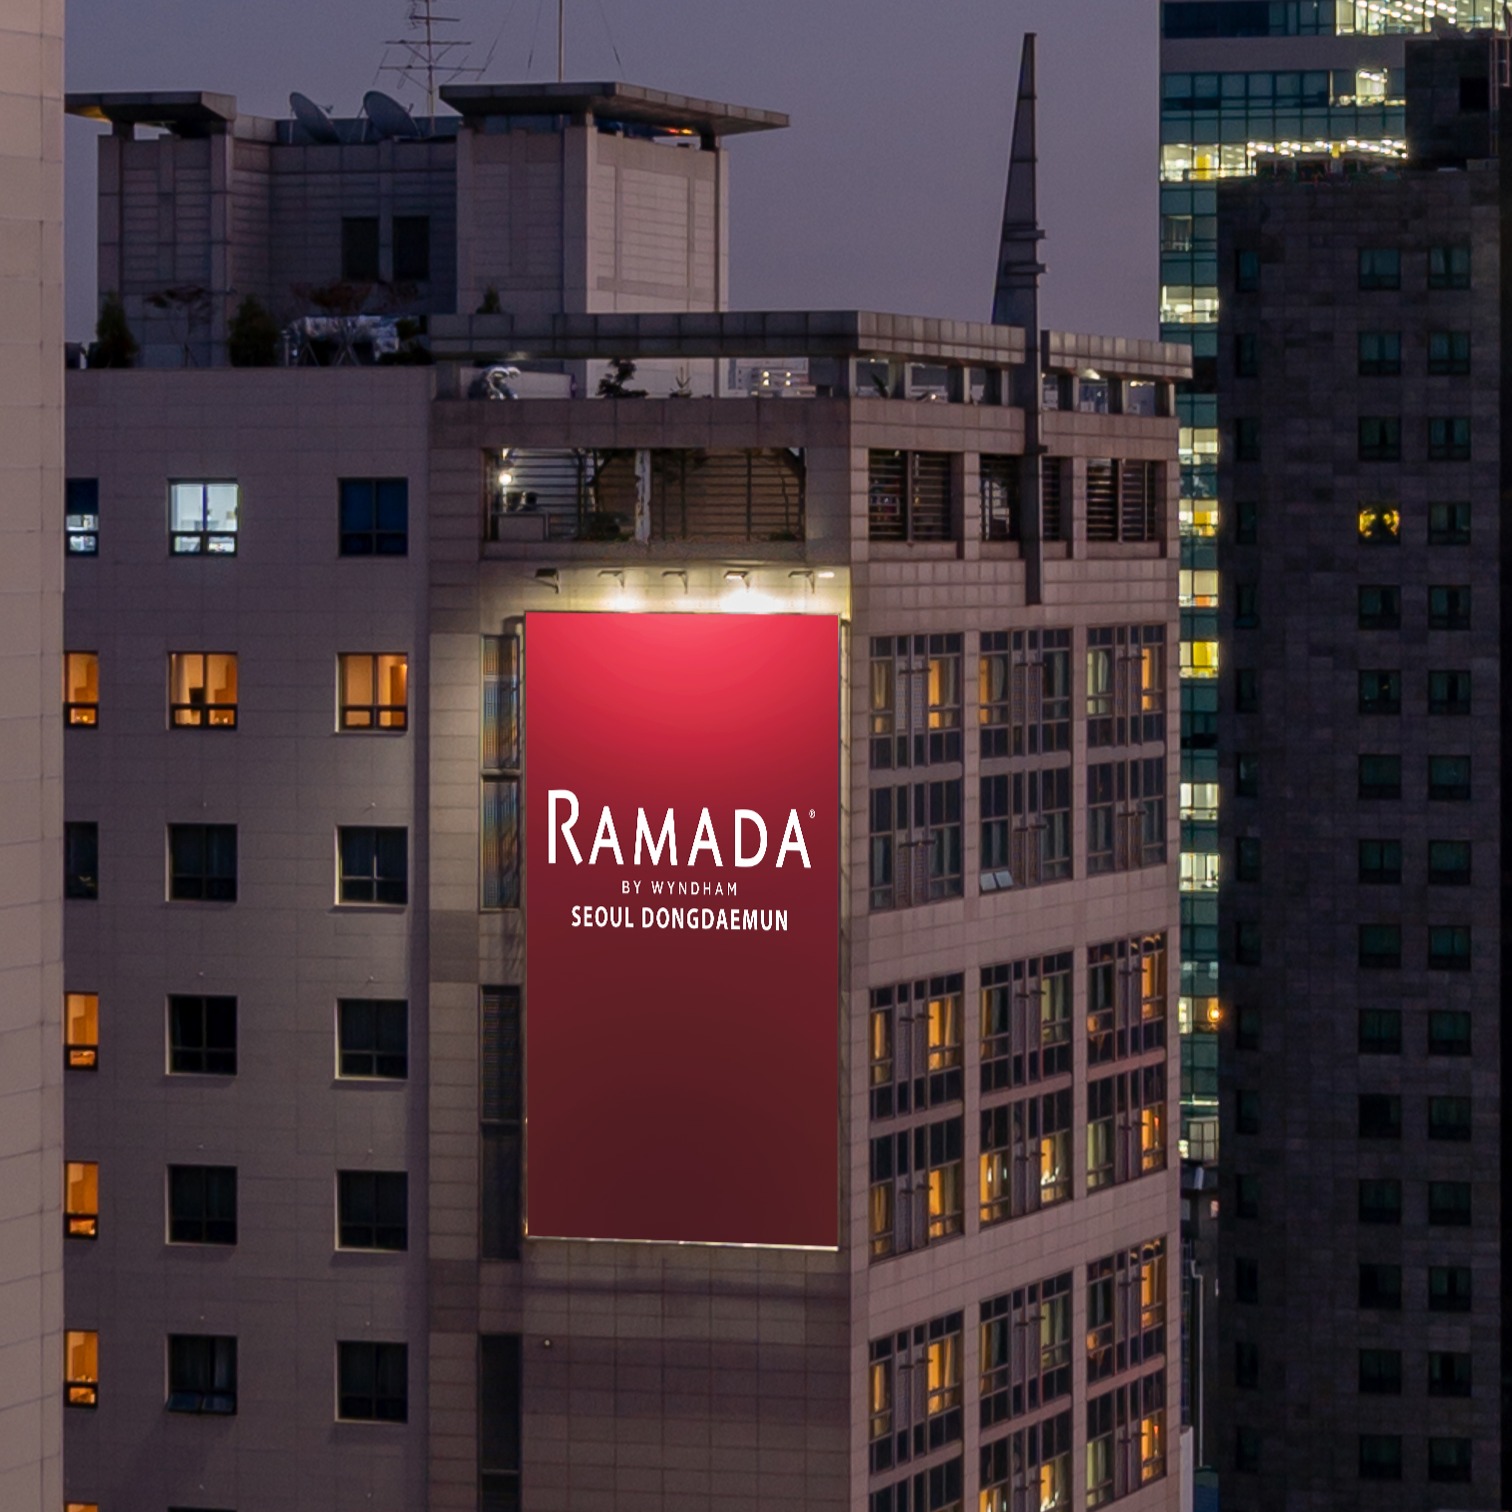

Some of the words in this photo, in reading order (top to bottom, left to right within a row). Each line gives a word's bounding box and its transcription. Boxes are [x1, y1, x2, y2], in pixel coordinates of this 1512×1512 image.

[548, 789, 812, 869] RAMADA
[621, 880, 642, 895] BY
[651, 880, 738, 897] WYNDHAM
[571, 905, 634, 929] SEOUL
[641, 907, 788, 931] DONGDAEMUN
